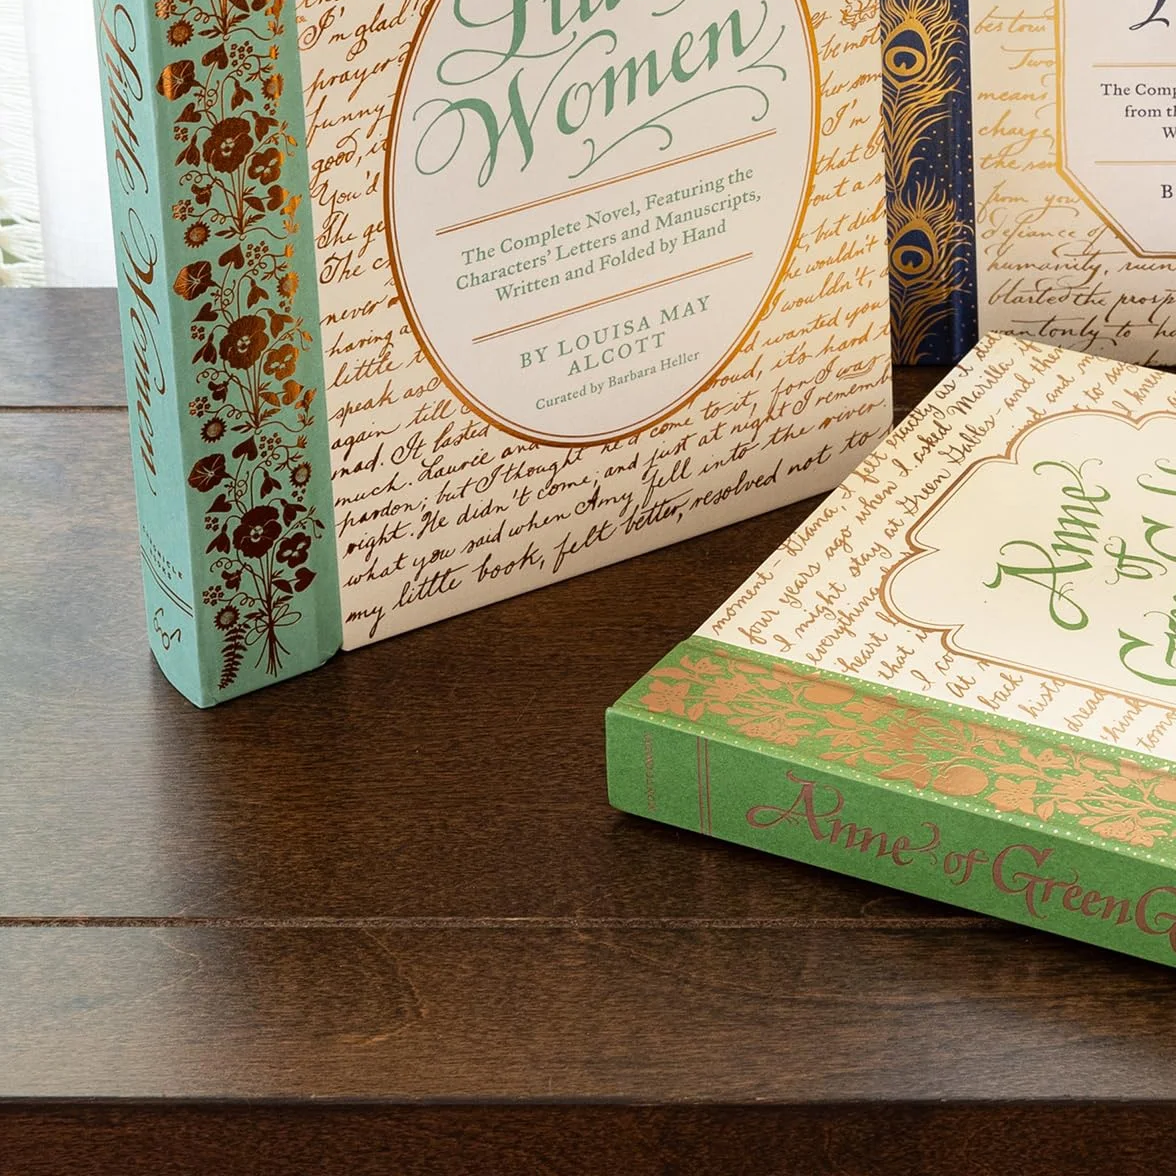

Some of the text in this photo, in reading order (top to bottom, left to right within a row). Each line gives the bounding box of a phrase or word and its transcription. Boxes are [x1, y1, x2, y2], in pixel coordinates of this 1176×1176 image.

[412, 0, 768, 188] Women
[1100, 83, 1130, 95] The
[1125, 104, 1161, 117] from
[461, 168, 753, 265] The Complete Novel, Featuring the
[555, 233, 616, 261] Letters
[620, 219, 649, 240] and
[655, 190, 760, 230] Manuscripts,
[495, 218, 726, 301] Written and Folded by Hand
[1070, 284, 1111, 307] the
[121, 207, 166, 497] Women
[519, 294, 709, 368] BY LOUISA MAY
[567, 331, 665, 376] ALCOTT
[535, 351, 699, 410] Curated by Barbara Heller
[345, 427, 881, 639] my little book, felt better, resolved not to
[983, 458, 1111, 631] Anne
[1104, 536, 1168, 586] of
[746, 769, 941, 866] Anne
[943, 848, 988, 886] of
